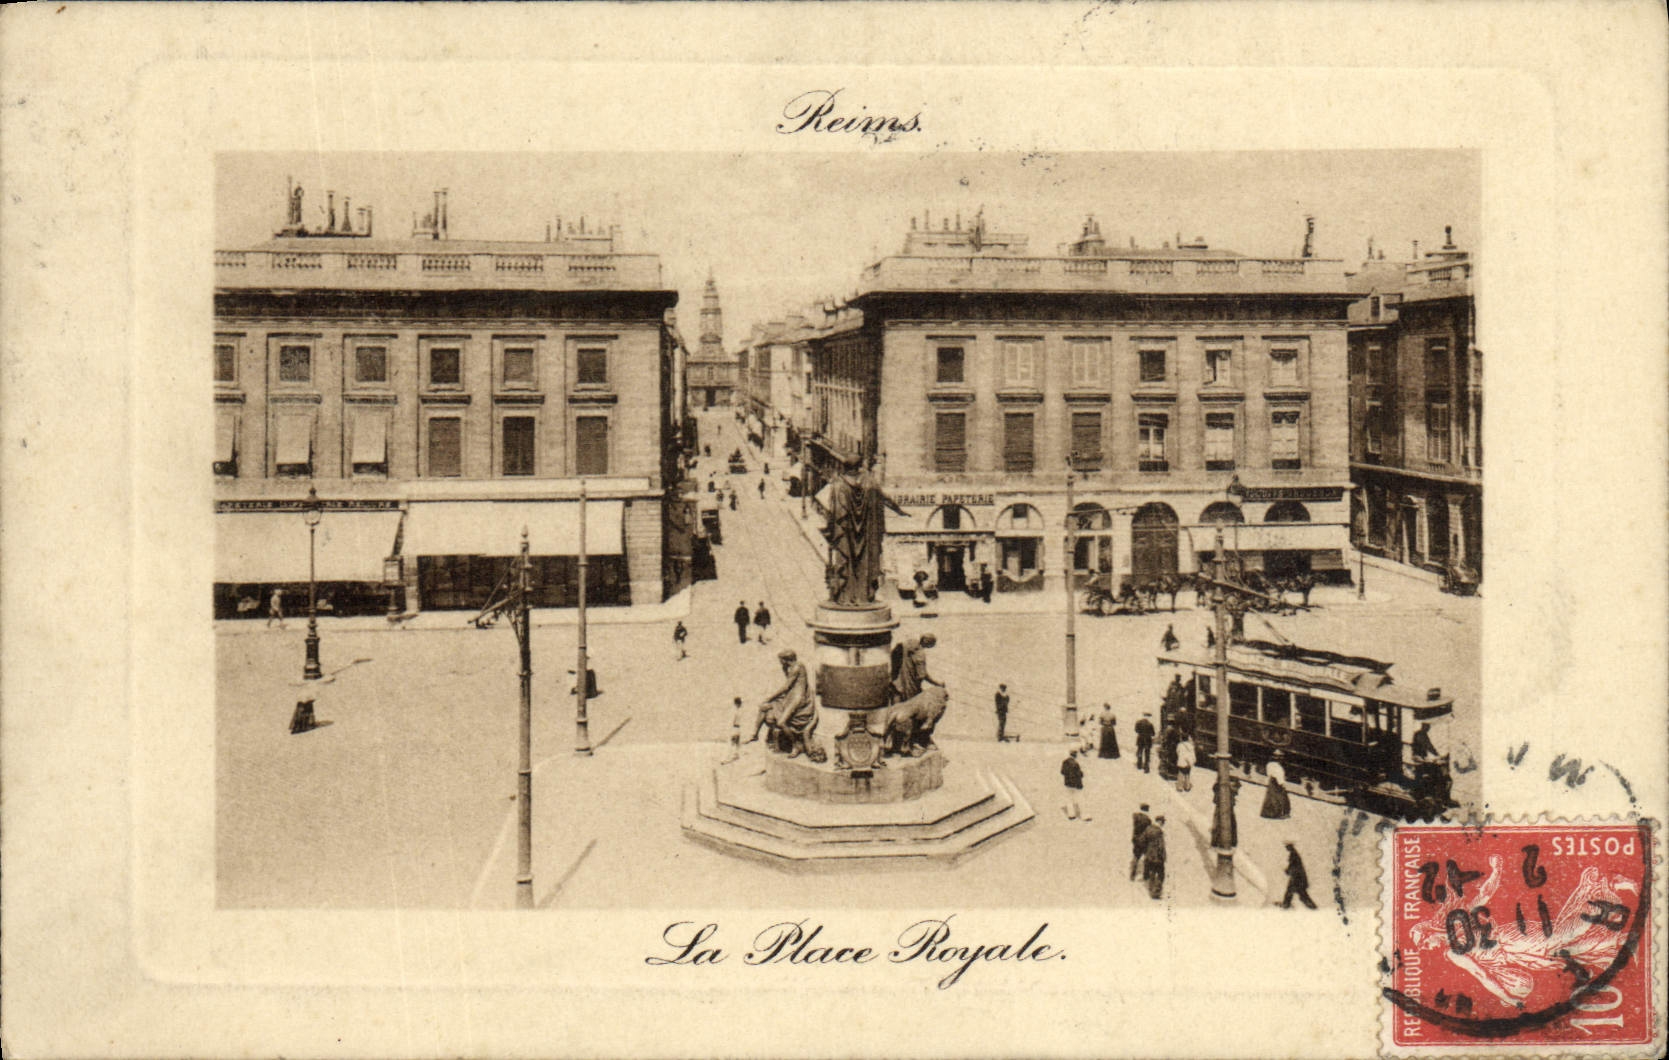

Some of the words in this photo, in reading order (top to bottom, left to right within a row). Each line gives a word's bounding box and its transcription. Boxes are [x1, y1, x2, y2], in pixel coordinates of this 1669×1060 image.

[889, 493, 936, 505] IBRAIRIE
[942, 492, 995, 505] PAPETERIE
[1551, 836, 1636, 856] POSTES
[1569, 984, 1624, 1036] 10
